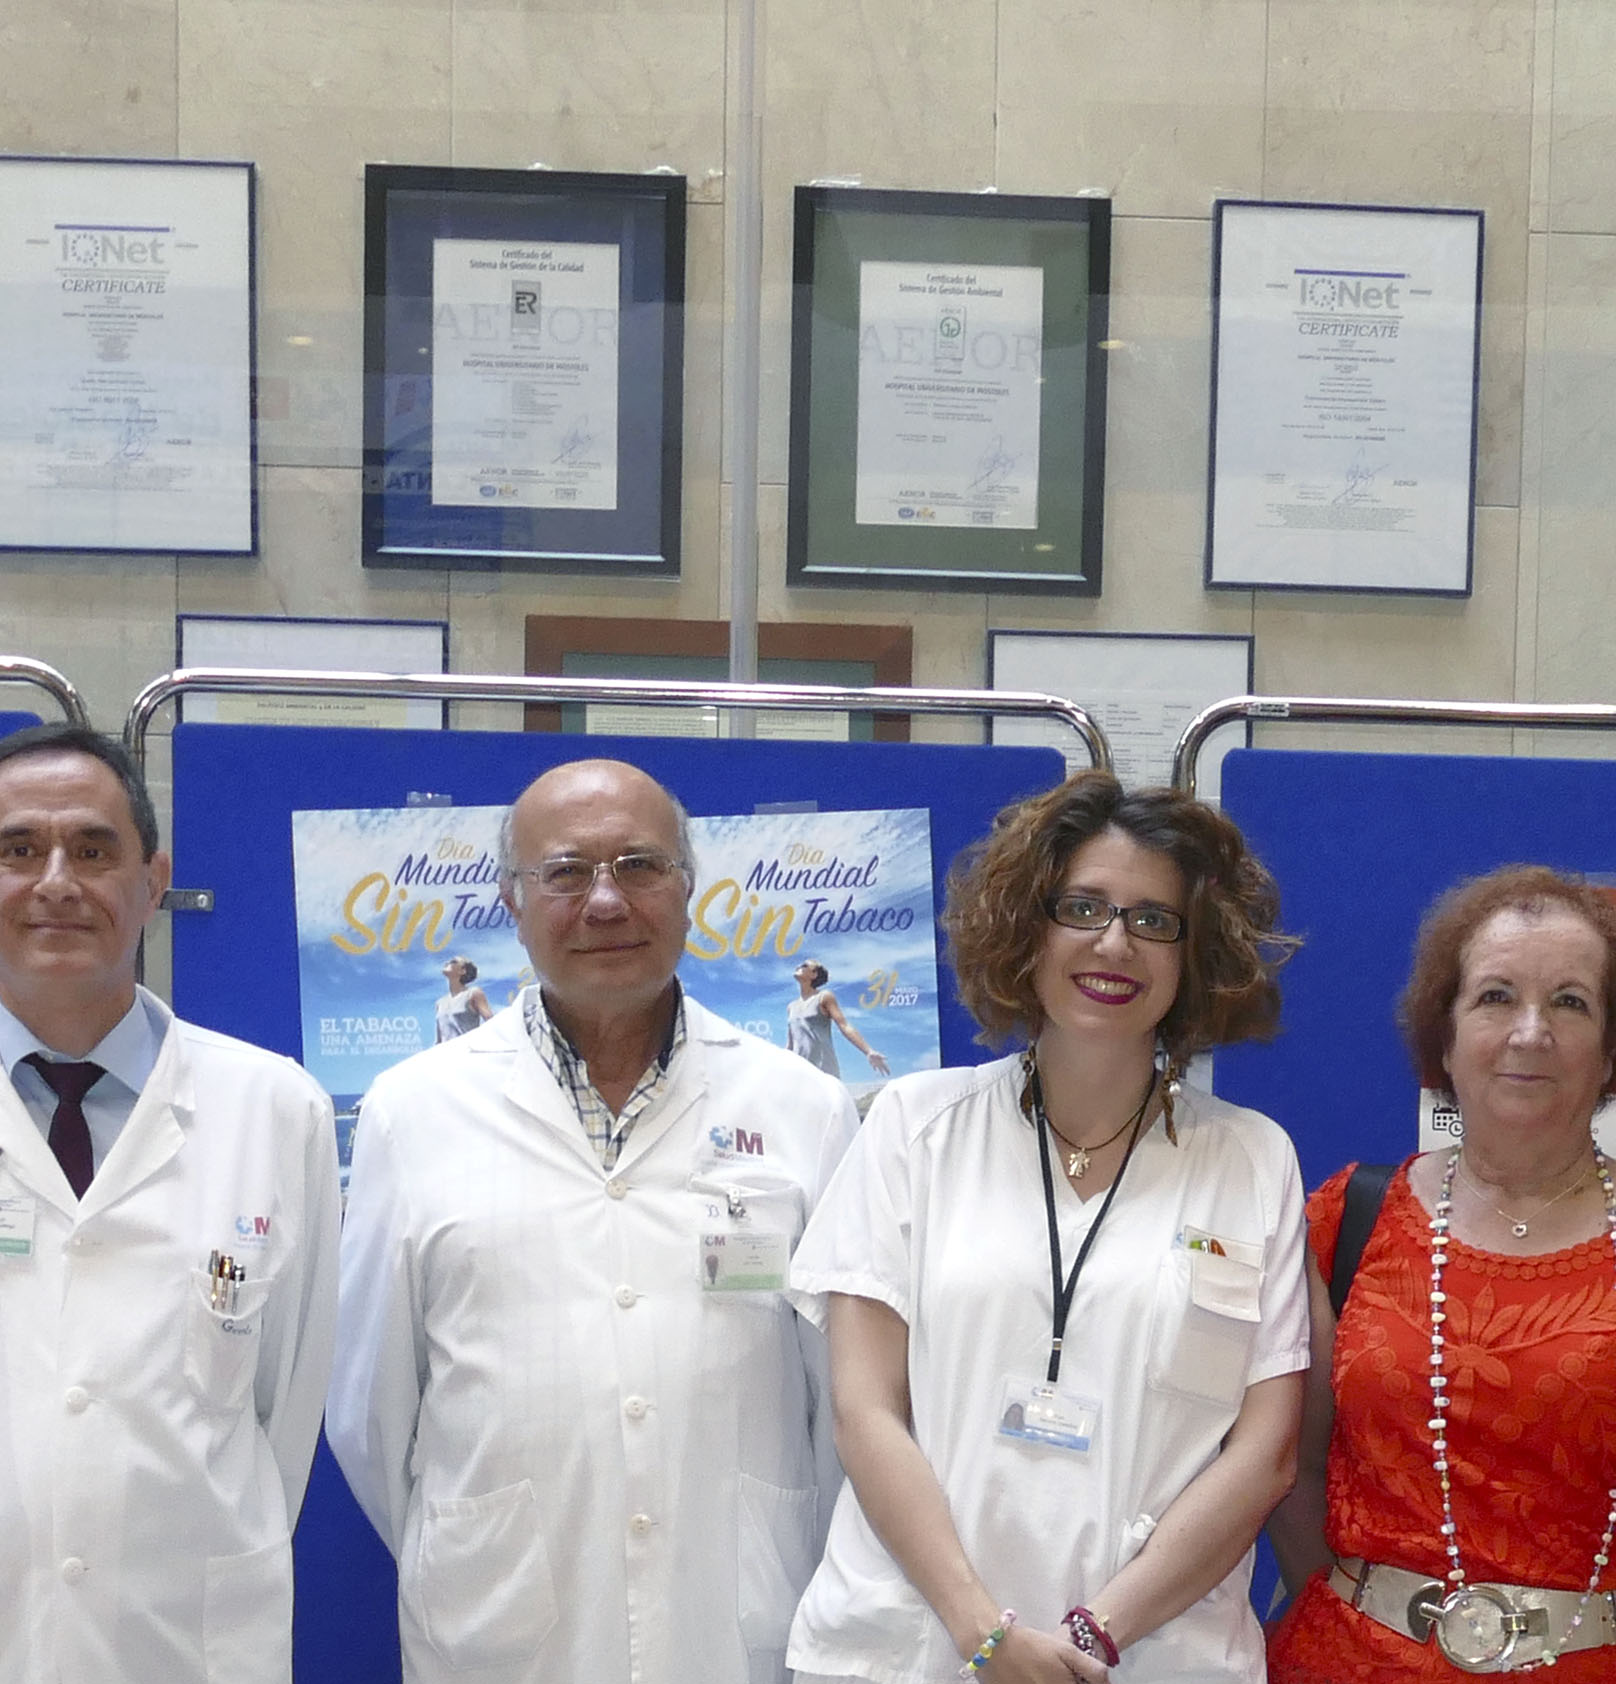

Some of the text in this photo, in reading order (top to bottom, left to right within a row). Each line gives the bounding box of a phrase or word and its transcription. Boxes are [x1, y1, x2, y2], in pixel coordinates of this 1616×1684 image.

[501, 249, 540, 260] Certificado
[61, 278, 166, 295] CERTIFICATE
[1298, 322, 1399, 338] CERTIFICATE
[437, 836, 476, 861] Día
[787, 842, 825, 866] Día
[745, 854, 880, 893] Mundial
[329, 870, 455, 956] Sin
[684, 877, 804, 961] Sin
[802, 893, 915, 935] Tabaco
[859, 968, 899, 1010] 31
[888, 994, 918, 1007] 2017
[319, 1016, 422, 1034] EL TABACO,
[320, 1033, 422, 1046] UNA AMENAZA
